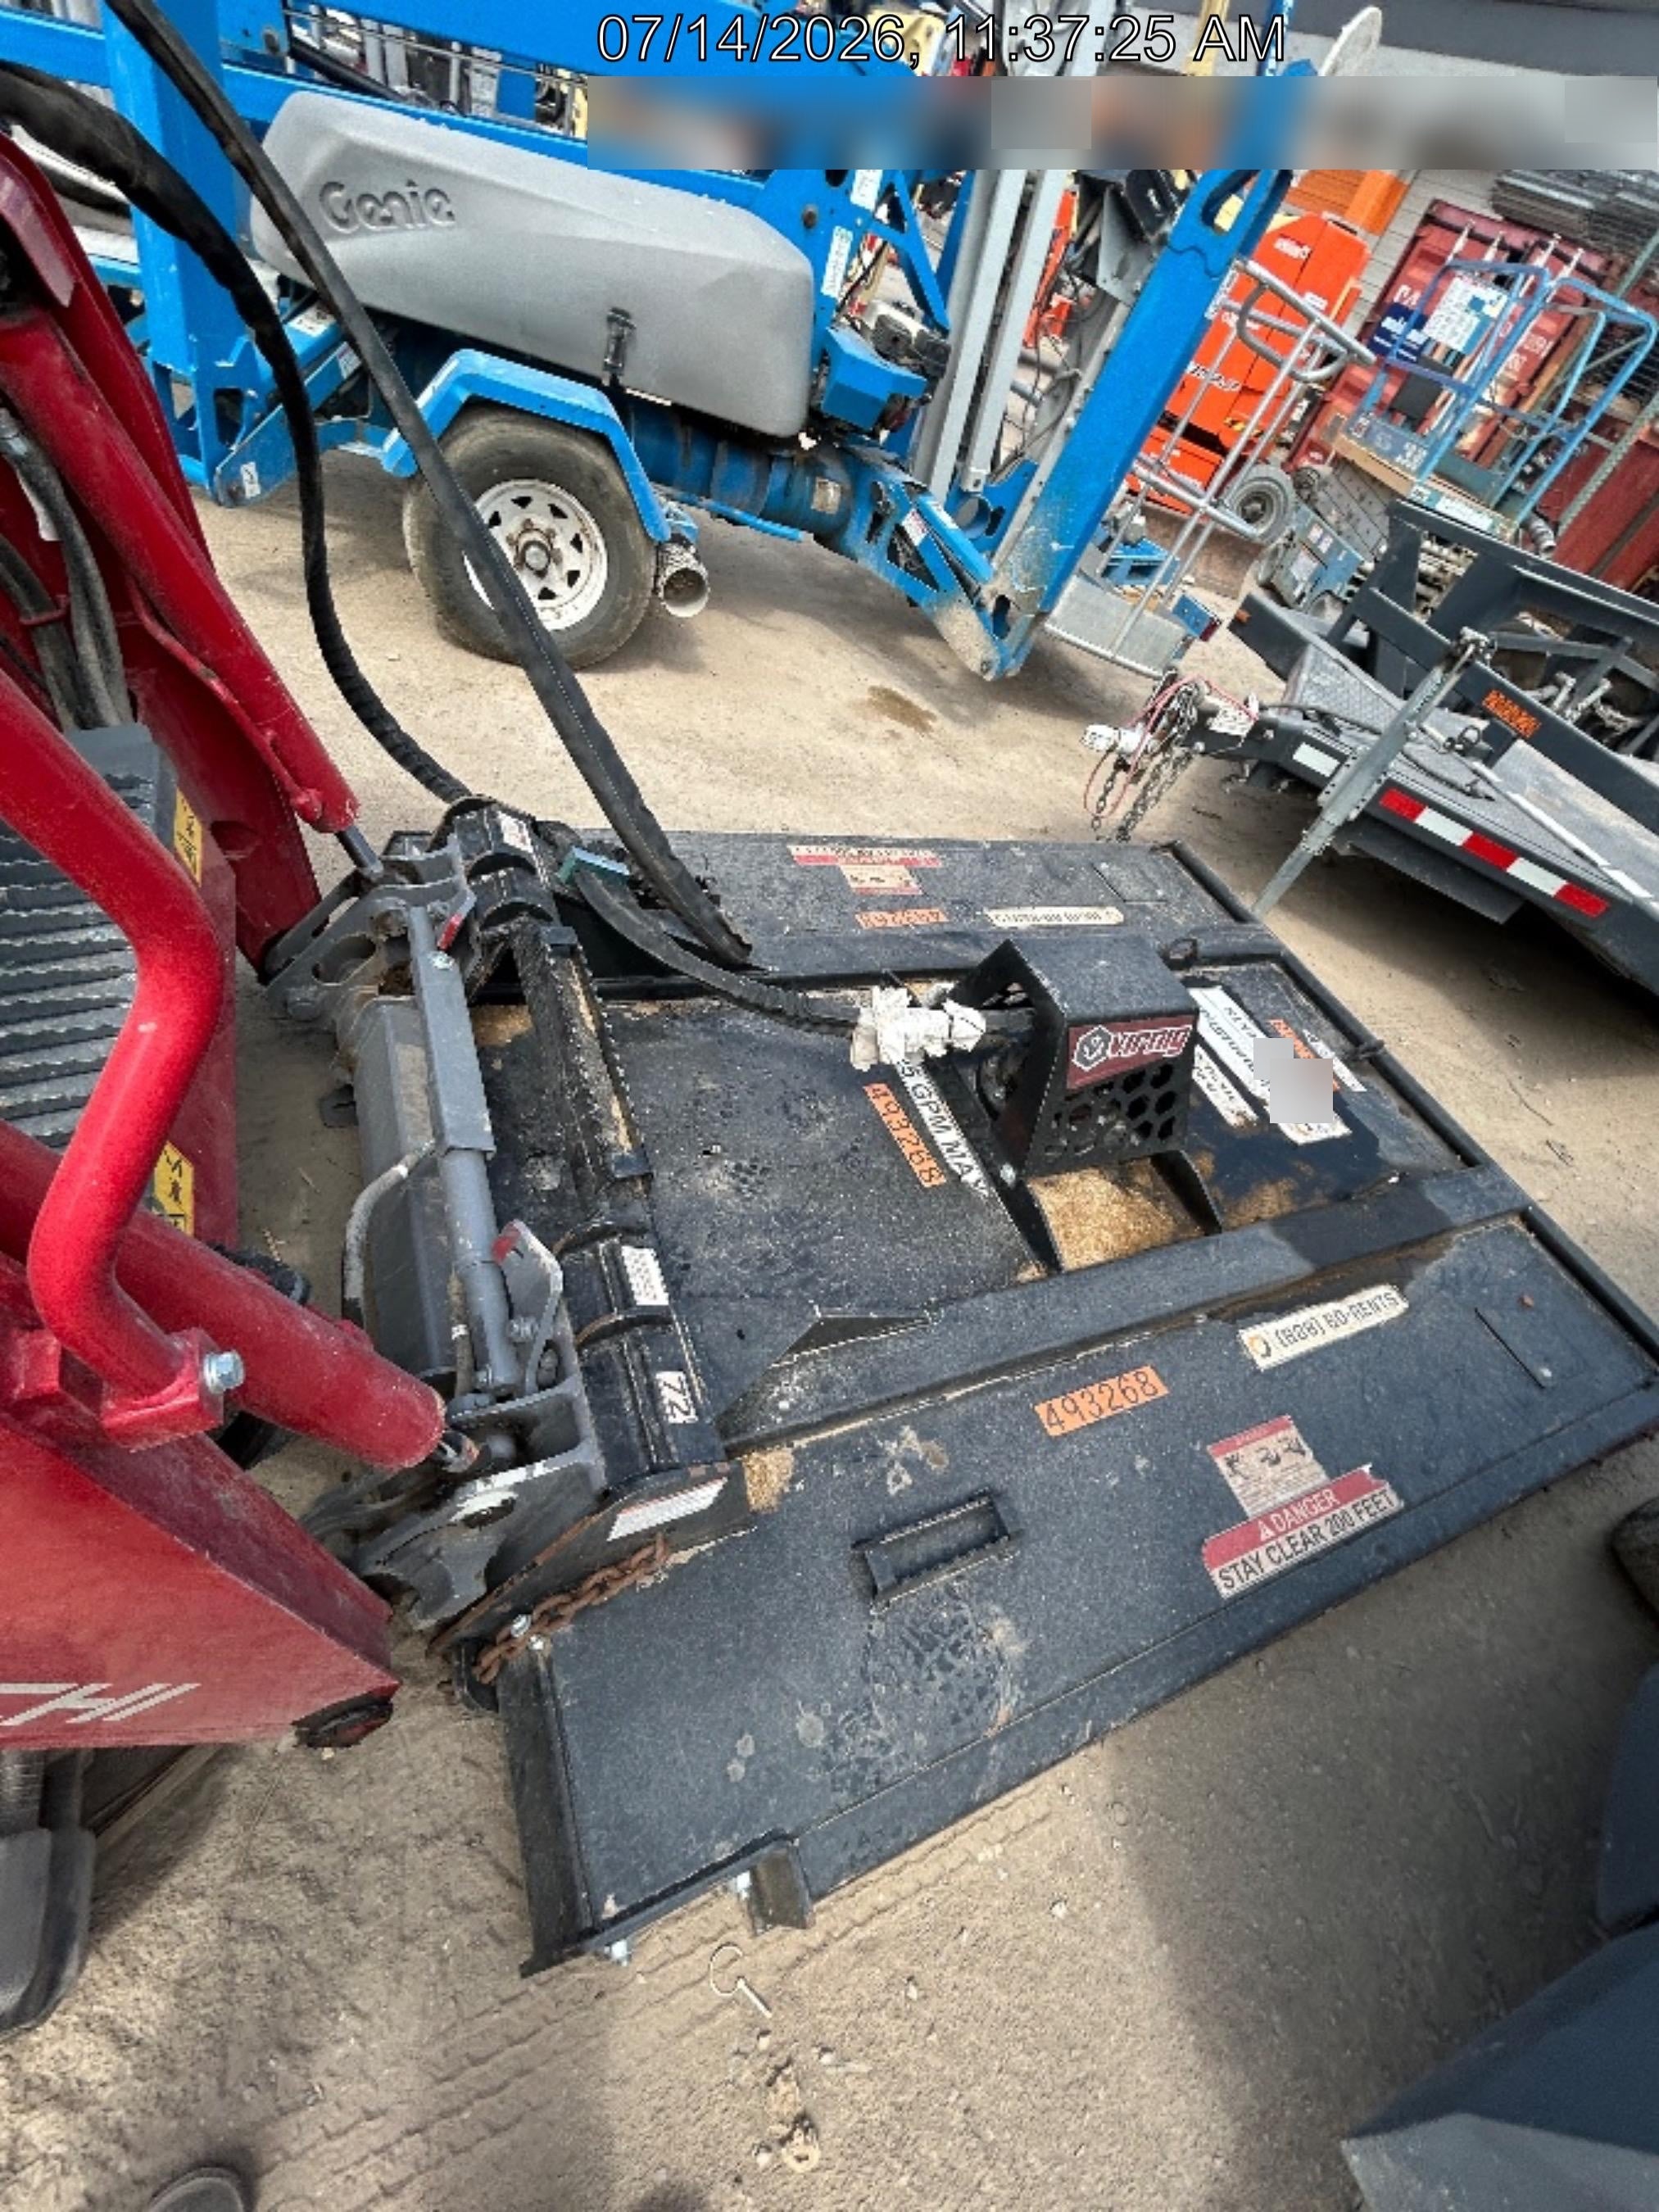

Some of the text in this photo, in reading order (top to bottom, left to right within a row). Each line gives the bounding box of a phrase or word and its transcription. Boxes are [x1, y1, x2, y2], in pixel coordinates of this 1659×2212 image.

[319, 178, 456, 234] Genie
[870, 1087, 945, 1183] 493268
[911, 1083, 953, 1135] GPM
[662, 1376, 691, 1419] 72
[1046, 1371, 1158, 1430] 493268
[1271, 1489, 1340, 1534] DANGER
[1218, 1489, 1394, 1589] STAY CLEAR 200 FEET
[0, 1682, 202, 1727] HI
